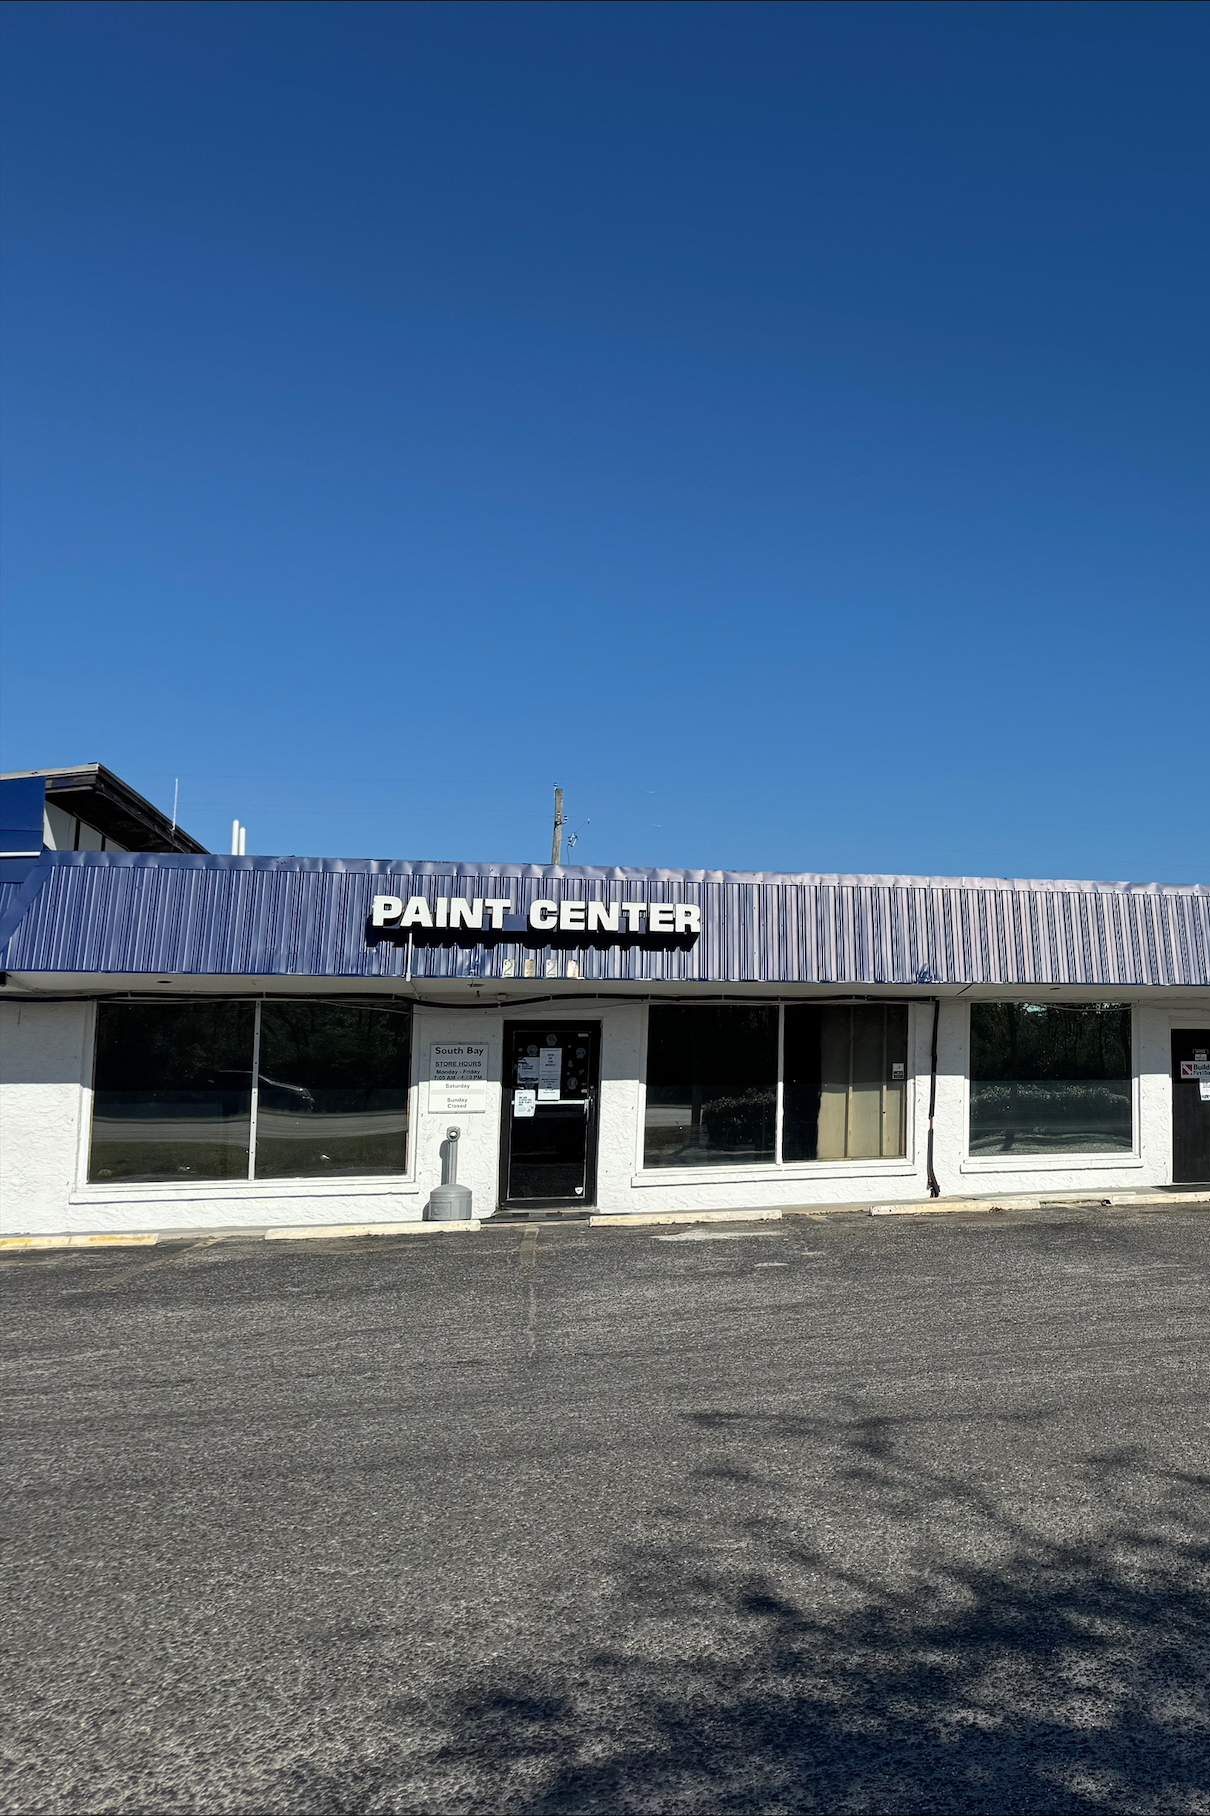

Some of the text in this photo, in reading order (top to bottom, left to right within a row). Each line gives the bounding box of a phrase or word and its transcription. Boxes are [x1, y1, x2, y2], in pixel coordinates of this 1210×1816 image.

[372, 895, 700, 933] PAINT CENTER
[435, 1046, 484, 1056] South Bay
